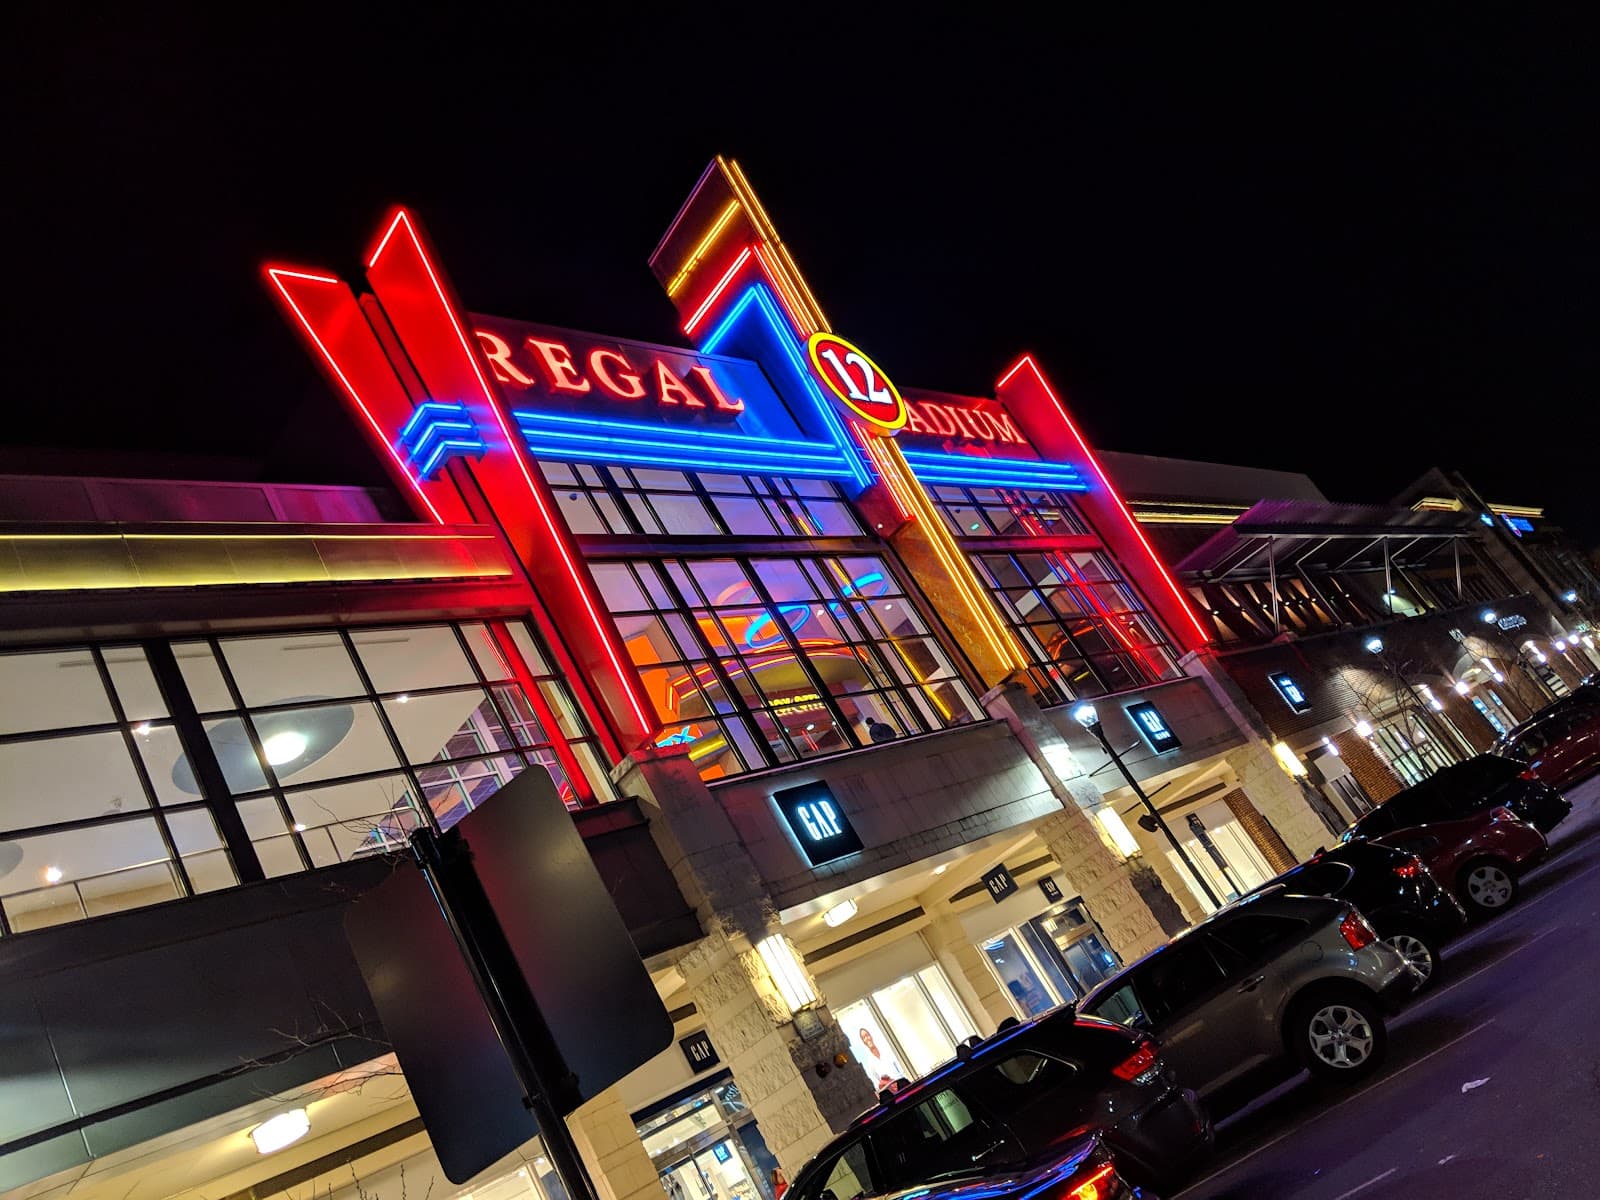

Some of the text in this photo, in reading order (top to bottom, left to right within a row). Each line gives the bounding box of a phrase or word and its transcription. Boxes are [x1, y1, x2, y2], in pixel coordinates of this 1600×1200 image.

[475, 331, 744, 411] REGAL
[821, 349, 893, 404] 12
[902, 400, 1027, 443] ADIUM
[797, 800, 842, 840] GAP
[989, 873, 1008, 894] GAP
[690, 1041, 710, 1061] GAP
